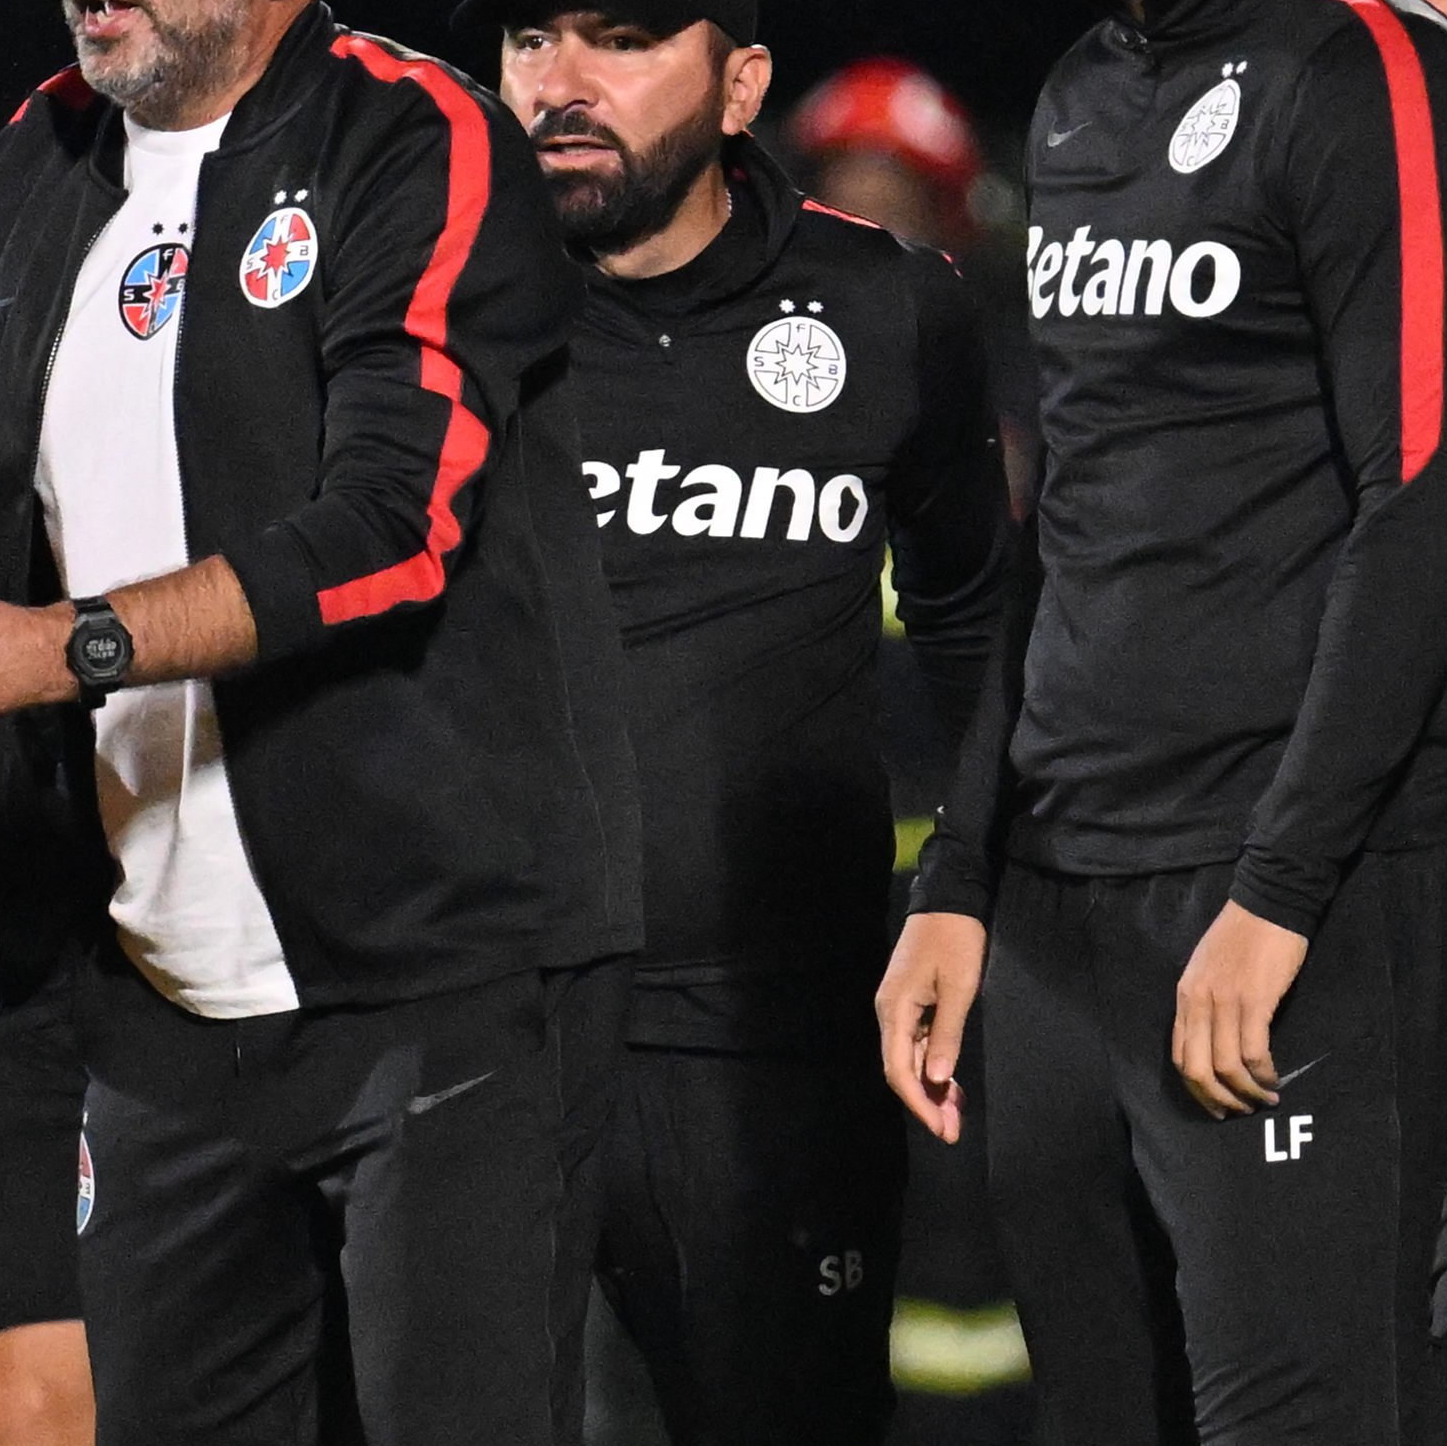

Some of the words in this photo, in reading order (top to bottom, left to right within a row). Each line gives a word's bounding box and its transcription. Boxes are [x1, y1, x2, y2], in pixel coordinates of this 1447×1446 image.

[580, 449, 870, 543] etano
[1264, 1114, 1314, 1163] LF
[817, 1248, 865, 1297] SB
